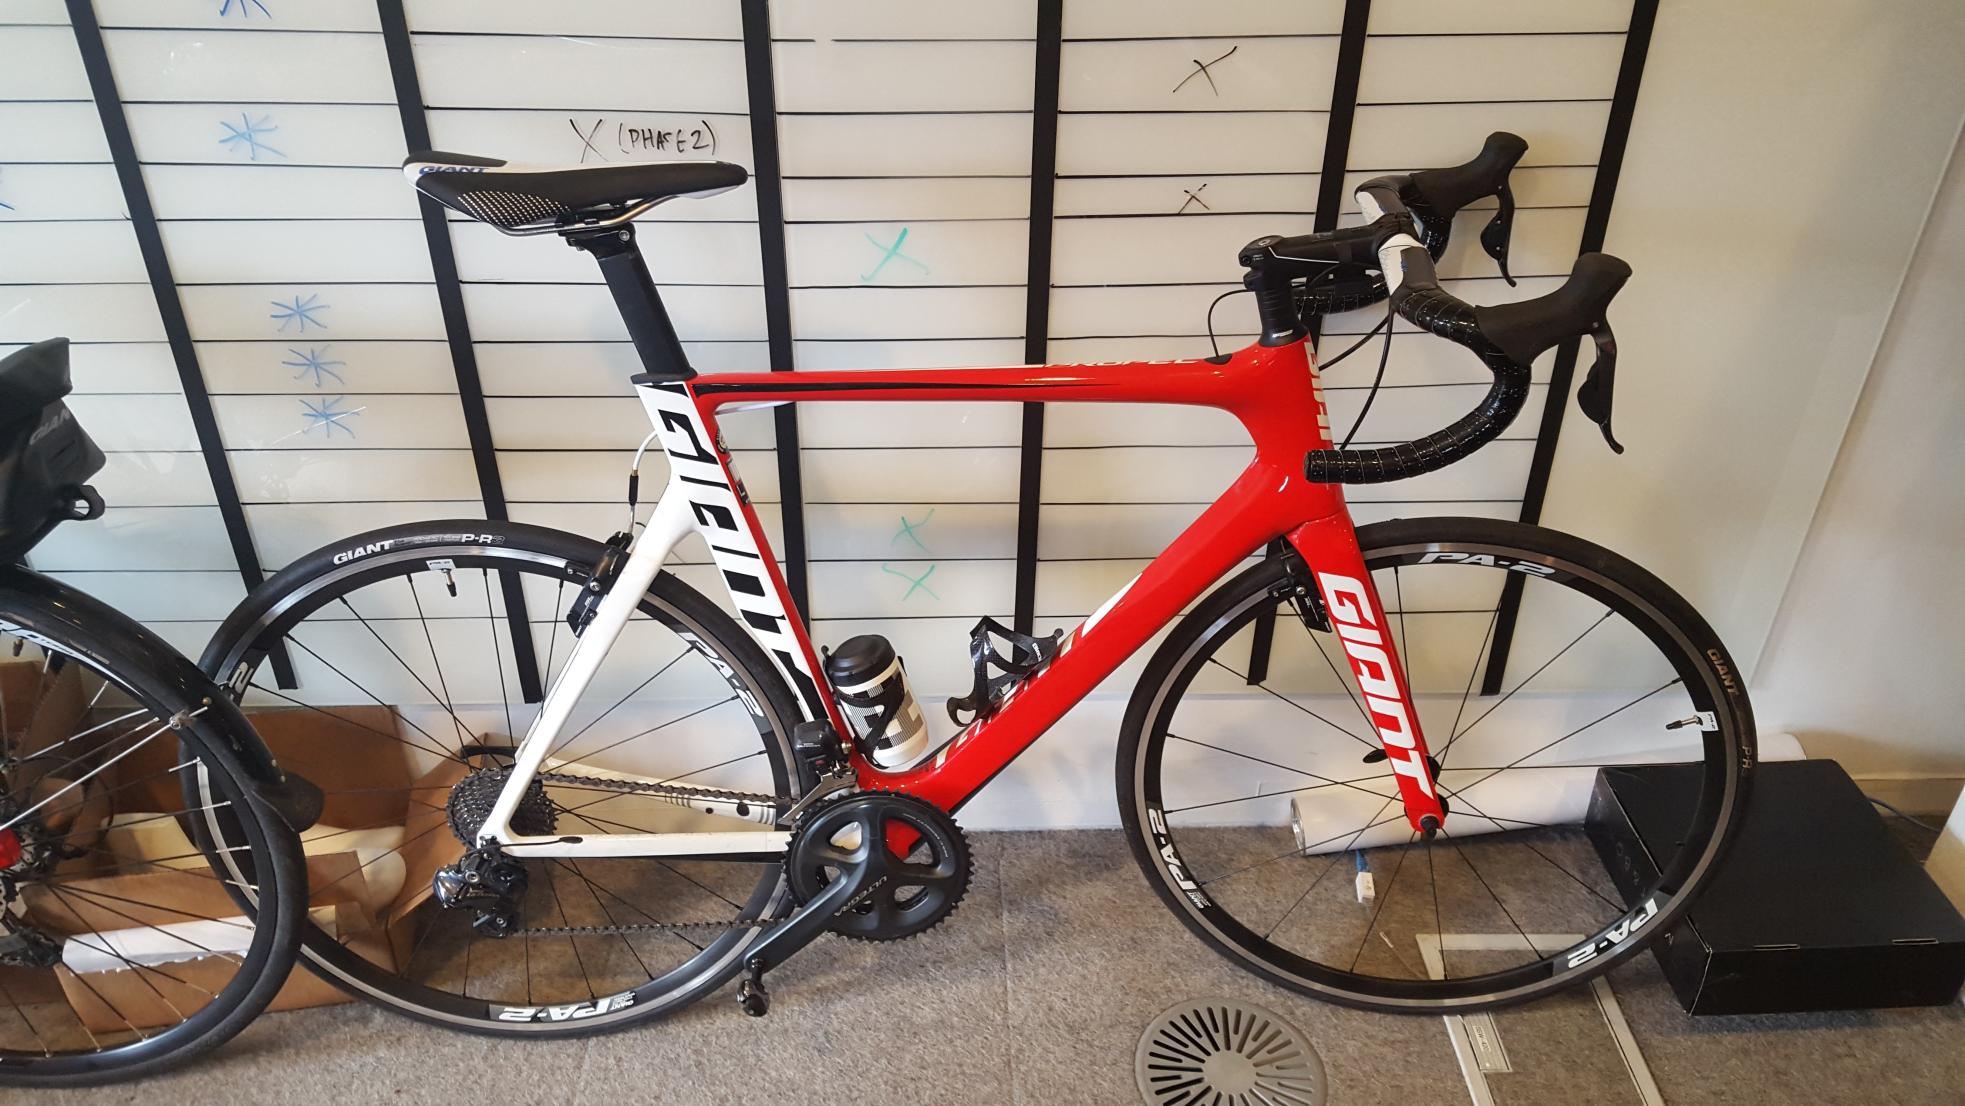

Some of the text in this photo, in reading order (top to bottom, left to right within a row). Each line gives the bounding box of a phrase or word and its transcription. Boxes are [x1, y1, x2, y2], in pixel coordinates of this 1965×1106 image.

[333, 539, 395, 566] GIANT
[1418, 552, 1556, 578] PA-2
[677, 632, 765, 717] PA-2
[1318, 571, 1434, 800] GIANT
[1707, 648, 1740, 695] GIANT
[1148, 808, 1198, 890] PA-2
[1567, 897, 1658, 969] PA-2
[498, 999, 611, 1022] PA-2
